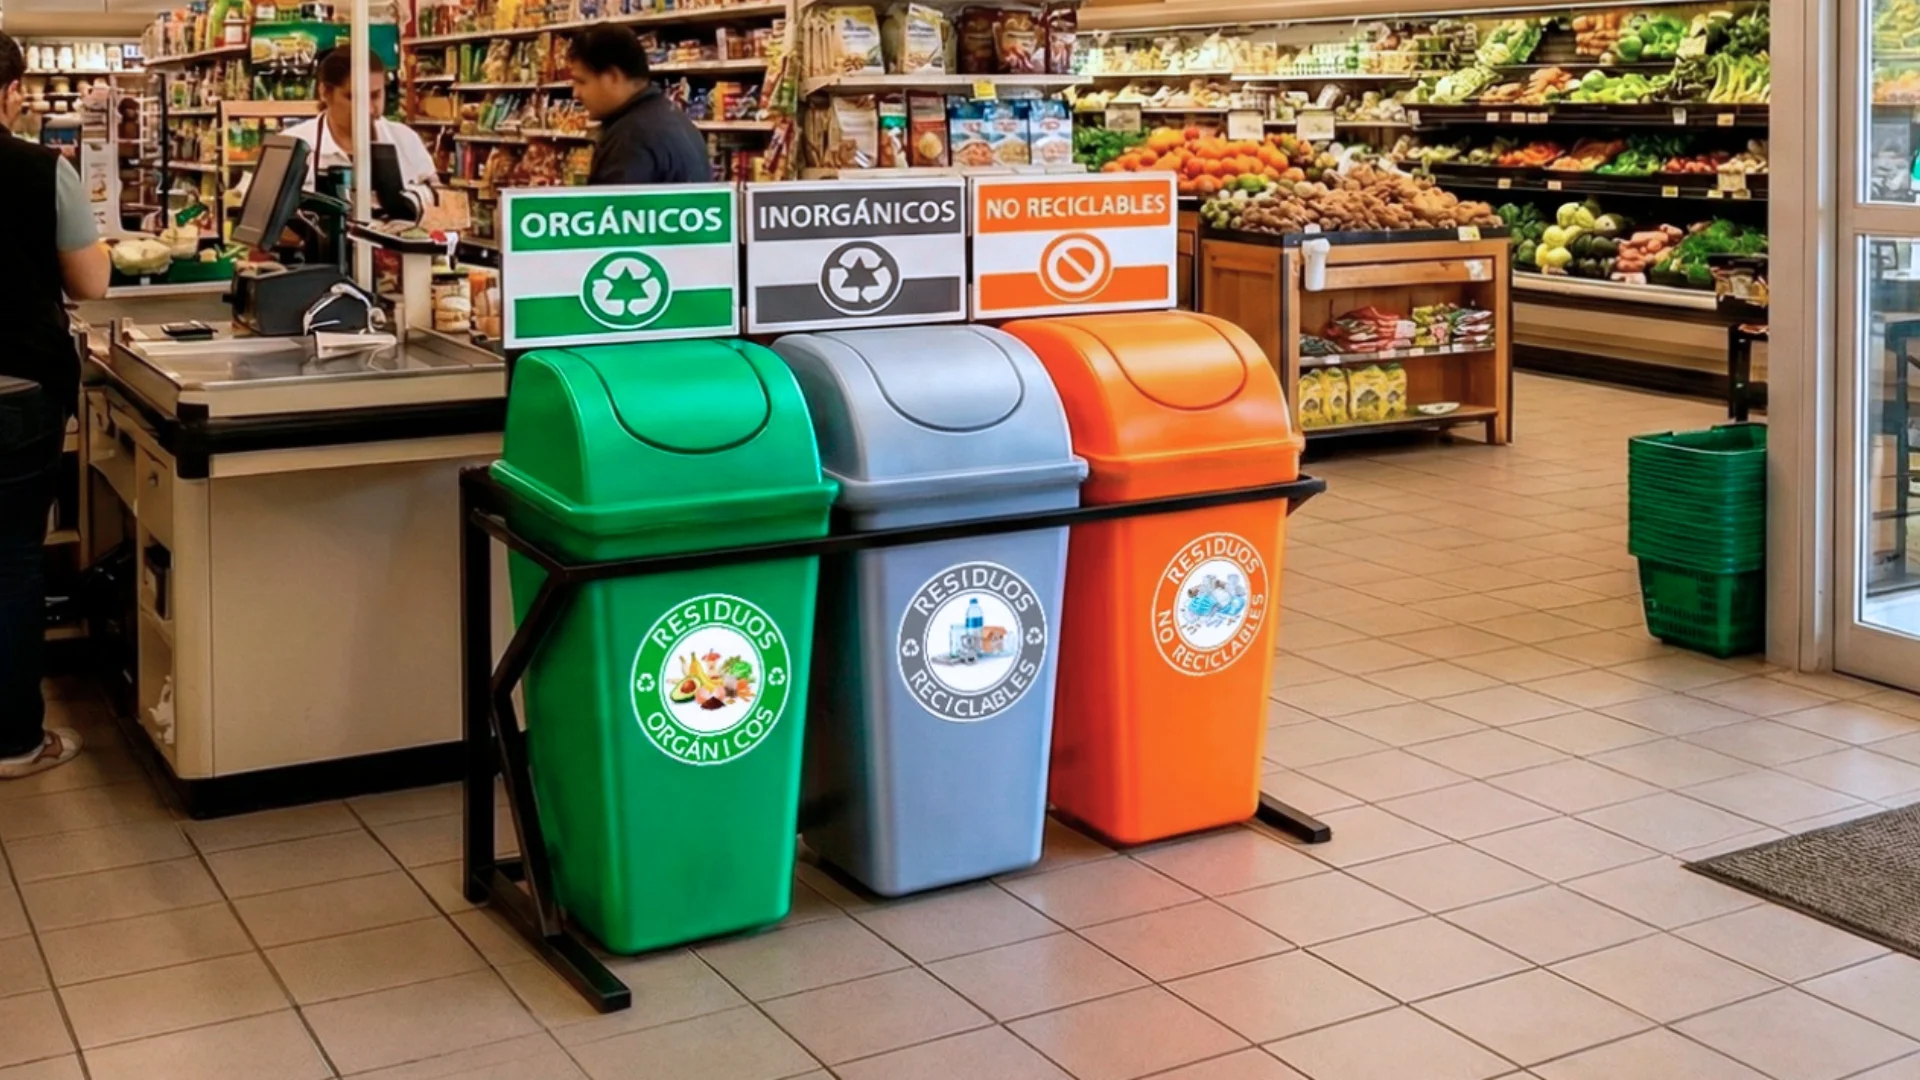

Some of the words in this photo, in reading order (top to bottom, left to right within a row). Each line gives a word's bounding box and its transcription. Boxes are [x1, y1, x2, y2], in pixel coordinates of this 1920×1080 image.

[520, 205, 723, 239] ORGÁNICOS
[759, 197, 957, 230] INORGÁNICOS
[985, 197, 1020, 220] NO
[1026, 193, 1166, 218] RECICLABLES
[1167, 537, 1261, 585] RESIDUOS
[913, 567, 1034, 617] RESIDUOS
[651, 600, 778, 650] RESIDUOS
[1157, 608, 1174, 644] NO
[1172, 593, 1264, 670] RECICLABLES
[909, 659, 1036, 717] RECICLABLES
